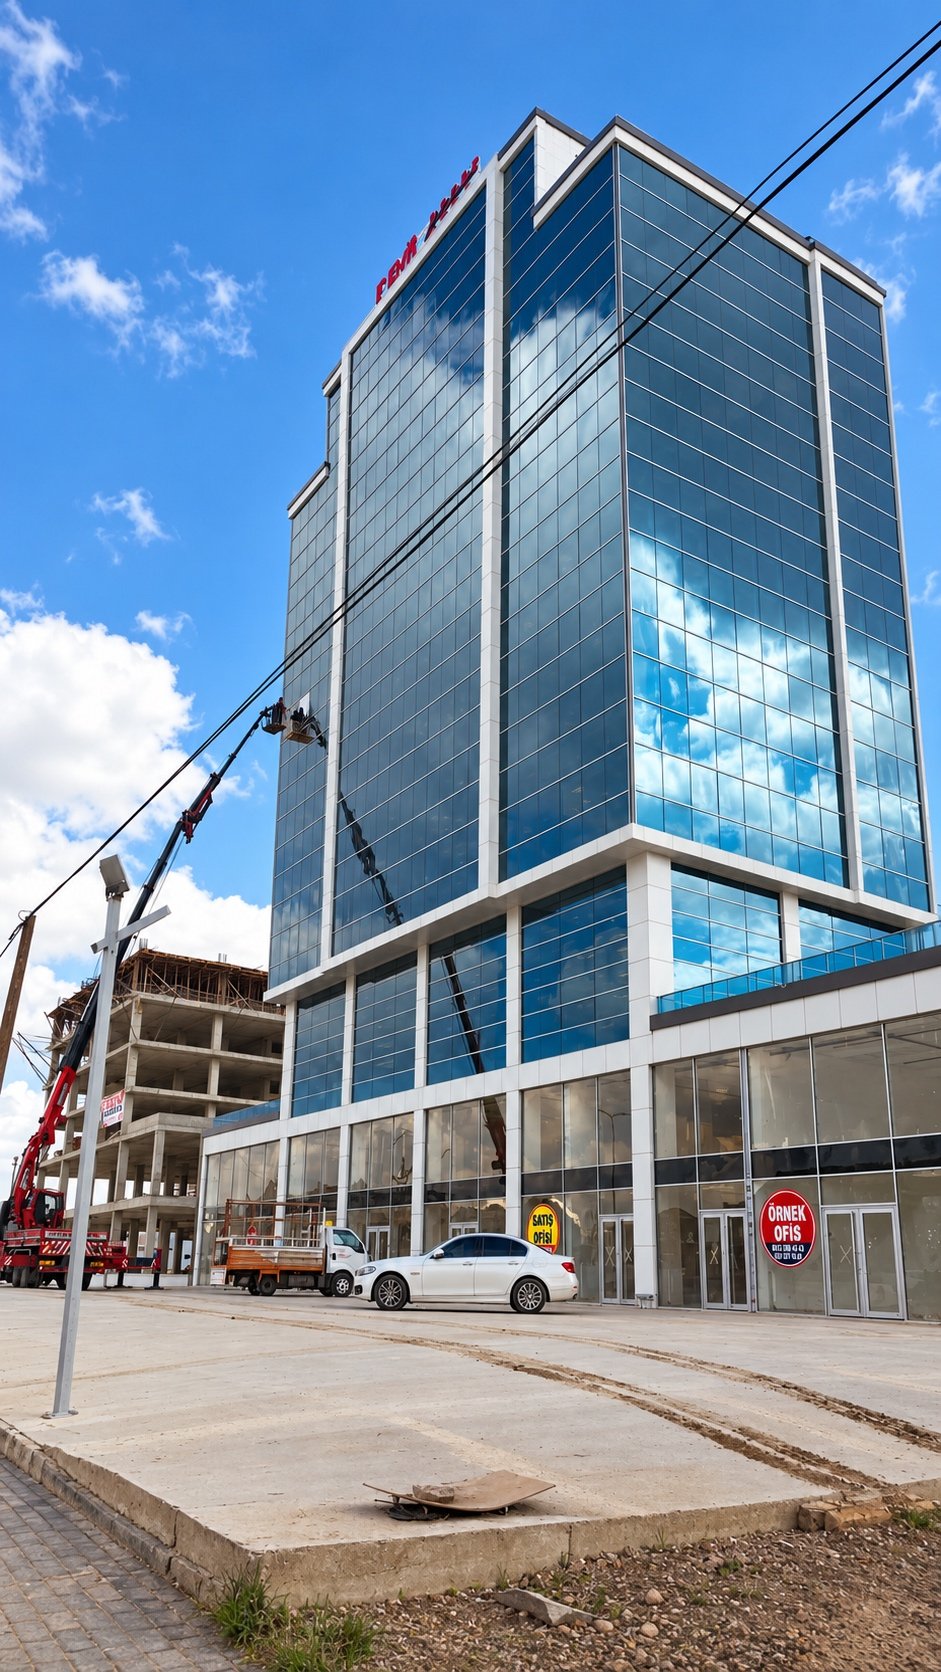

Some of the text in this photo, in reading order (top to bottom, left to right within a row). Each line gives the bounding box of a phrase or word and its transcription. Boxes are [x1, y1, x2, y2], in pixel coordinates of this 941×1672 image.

[532, 1213, 554, 1228] SATIŞ
[768, 1202, 807, 1222] ÖRNEK
[774, 1222, 802, 1242] OFİS
